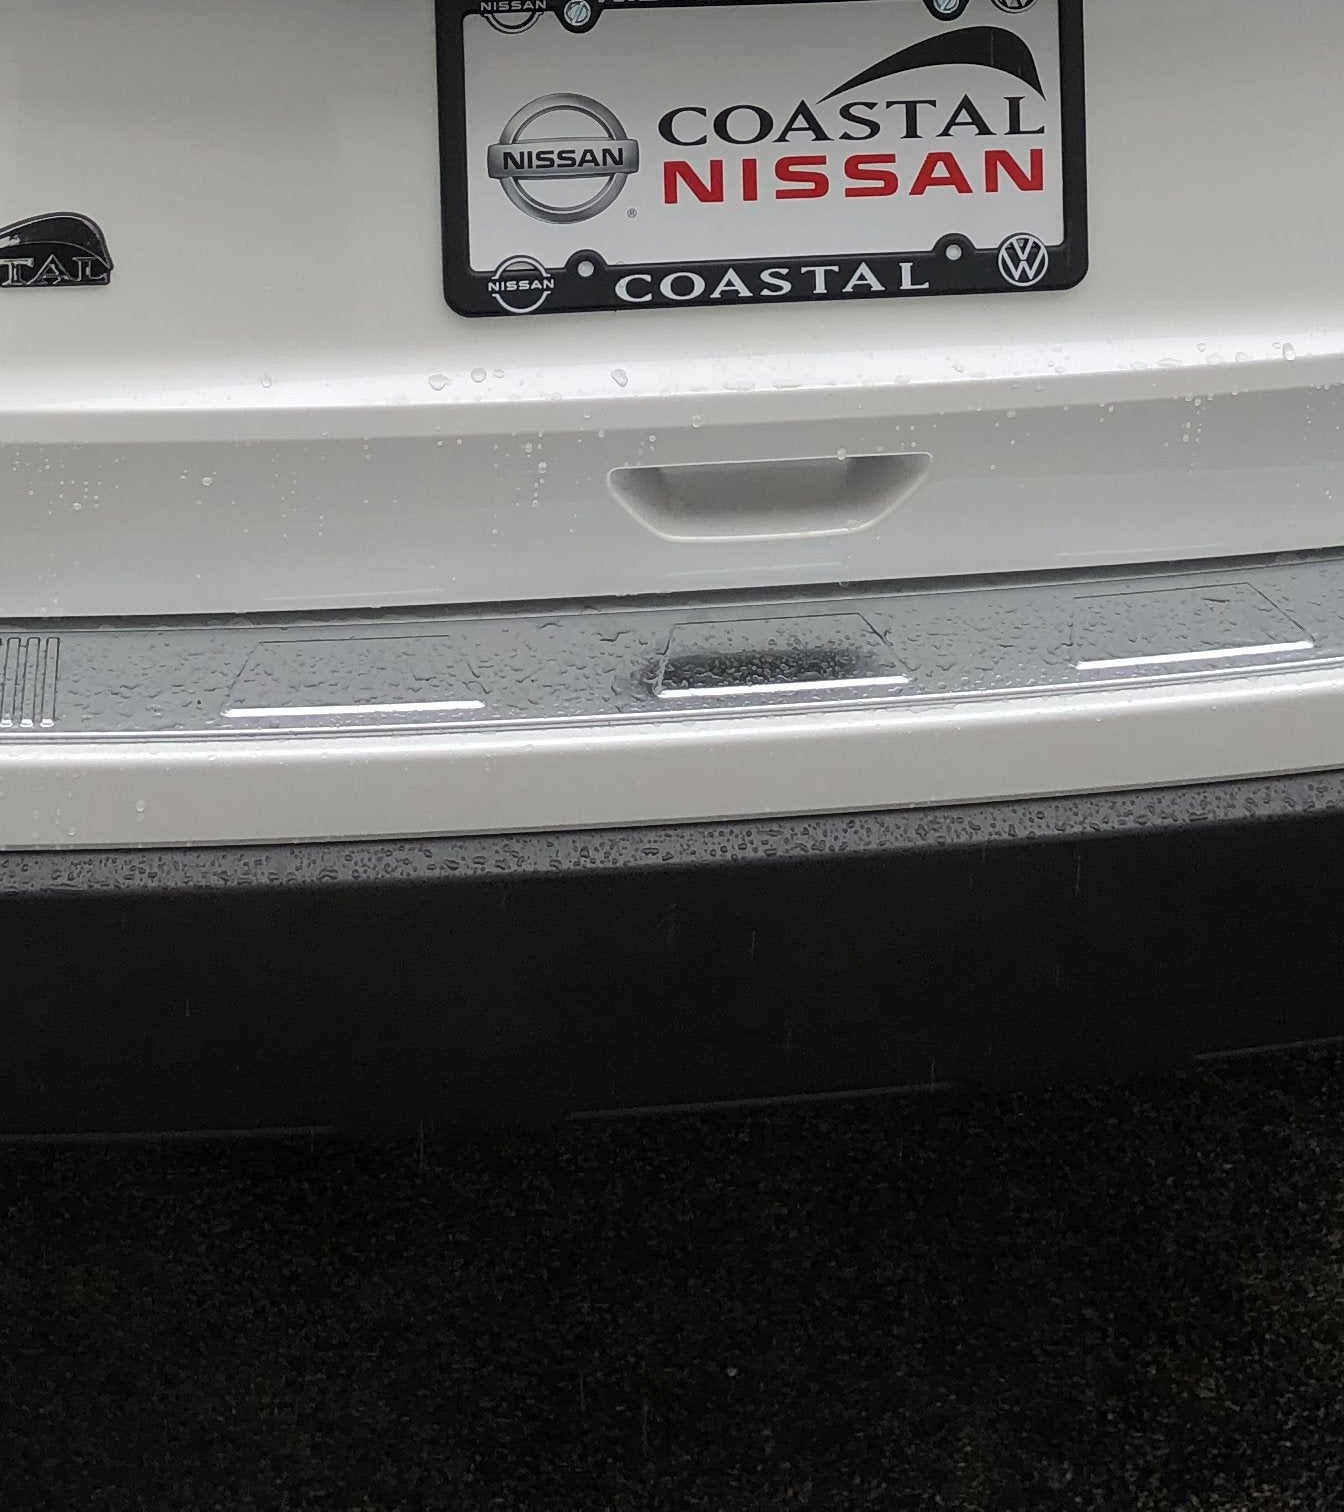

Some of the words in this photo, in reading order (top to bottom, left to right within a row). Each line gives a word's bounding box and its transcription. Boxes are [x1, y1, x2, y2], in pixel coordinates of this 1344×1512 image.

[480, 0, 546, 11] NISSAN
[657, 93, 1046, 146] COASTAL
[503, 146, 624, 170] NISSAN
[663, 148, 1044, 204] NISSAN
[488, 275, 555, 292] NISSAN
[614, 261, 930, 303] COASTAL
